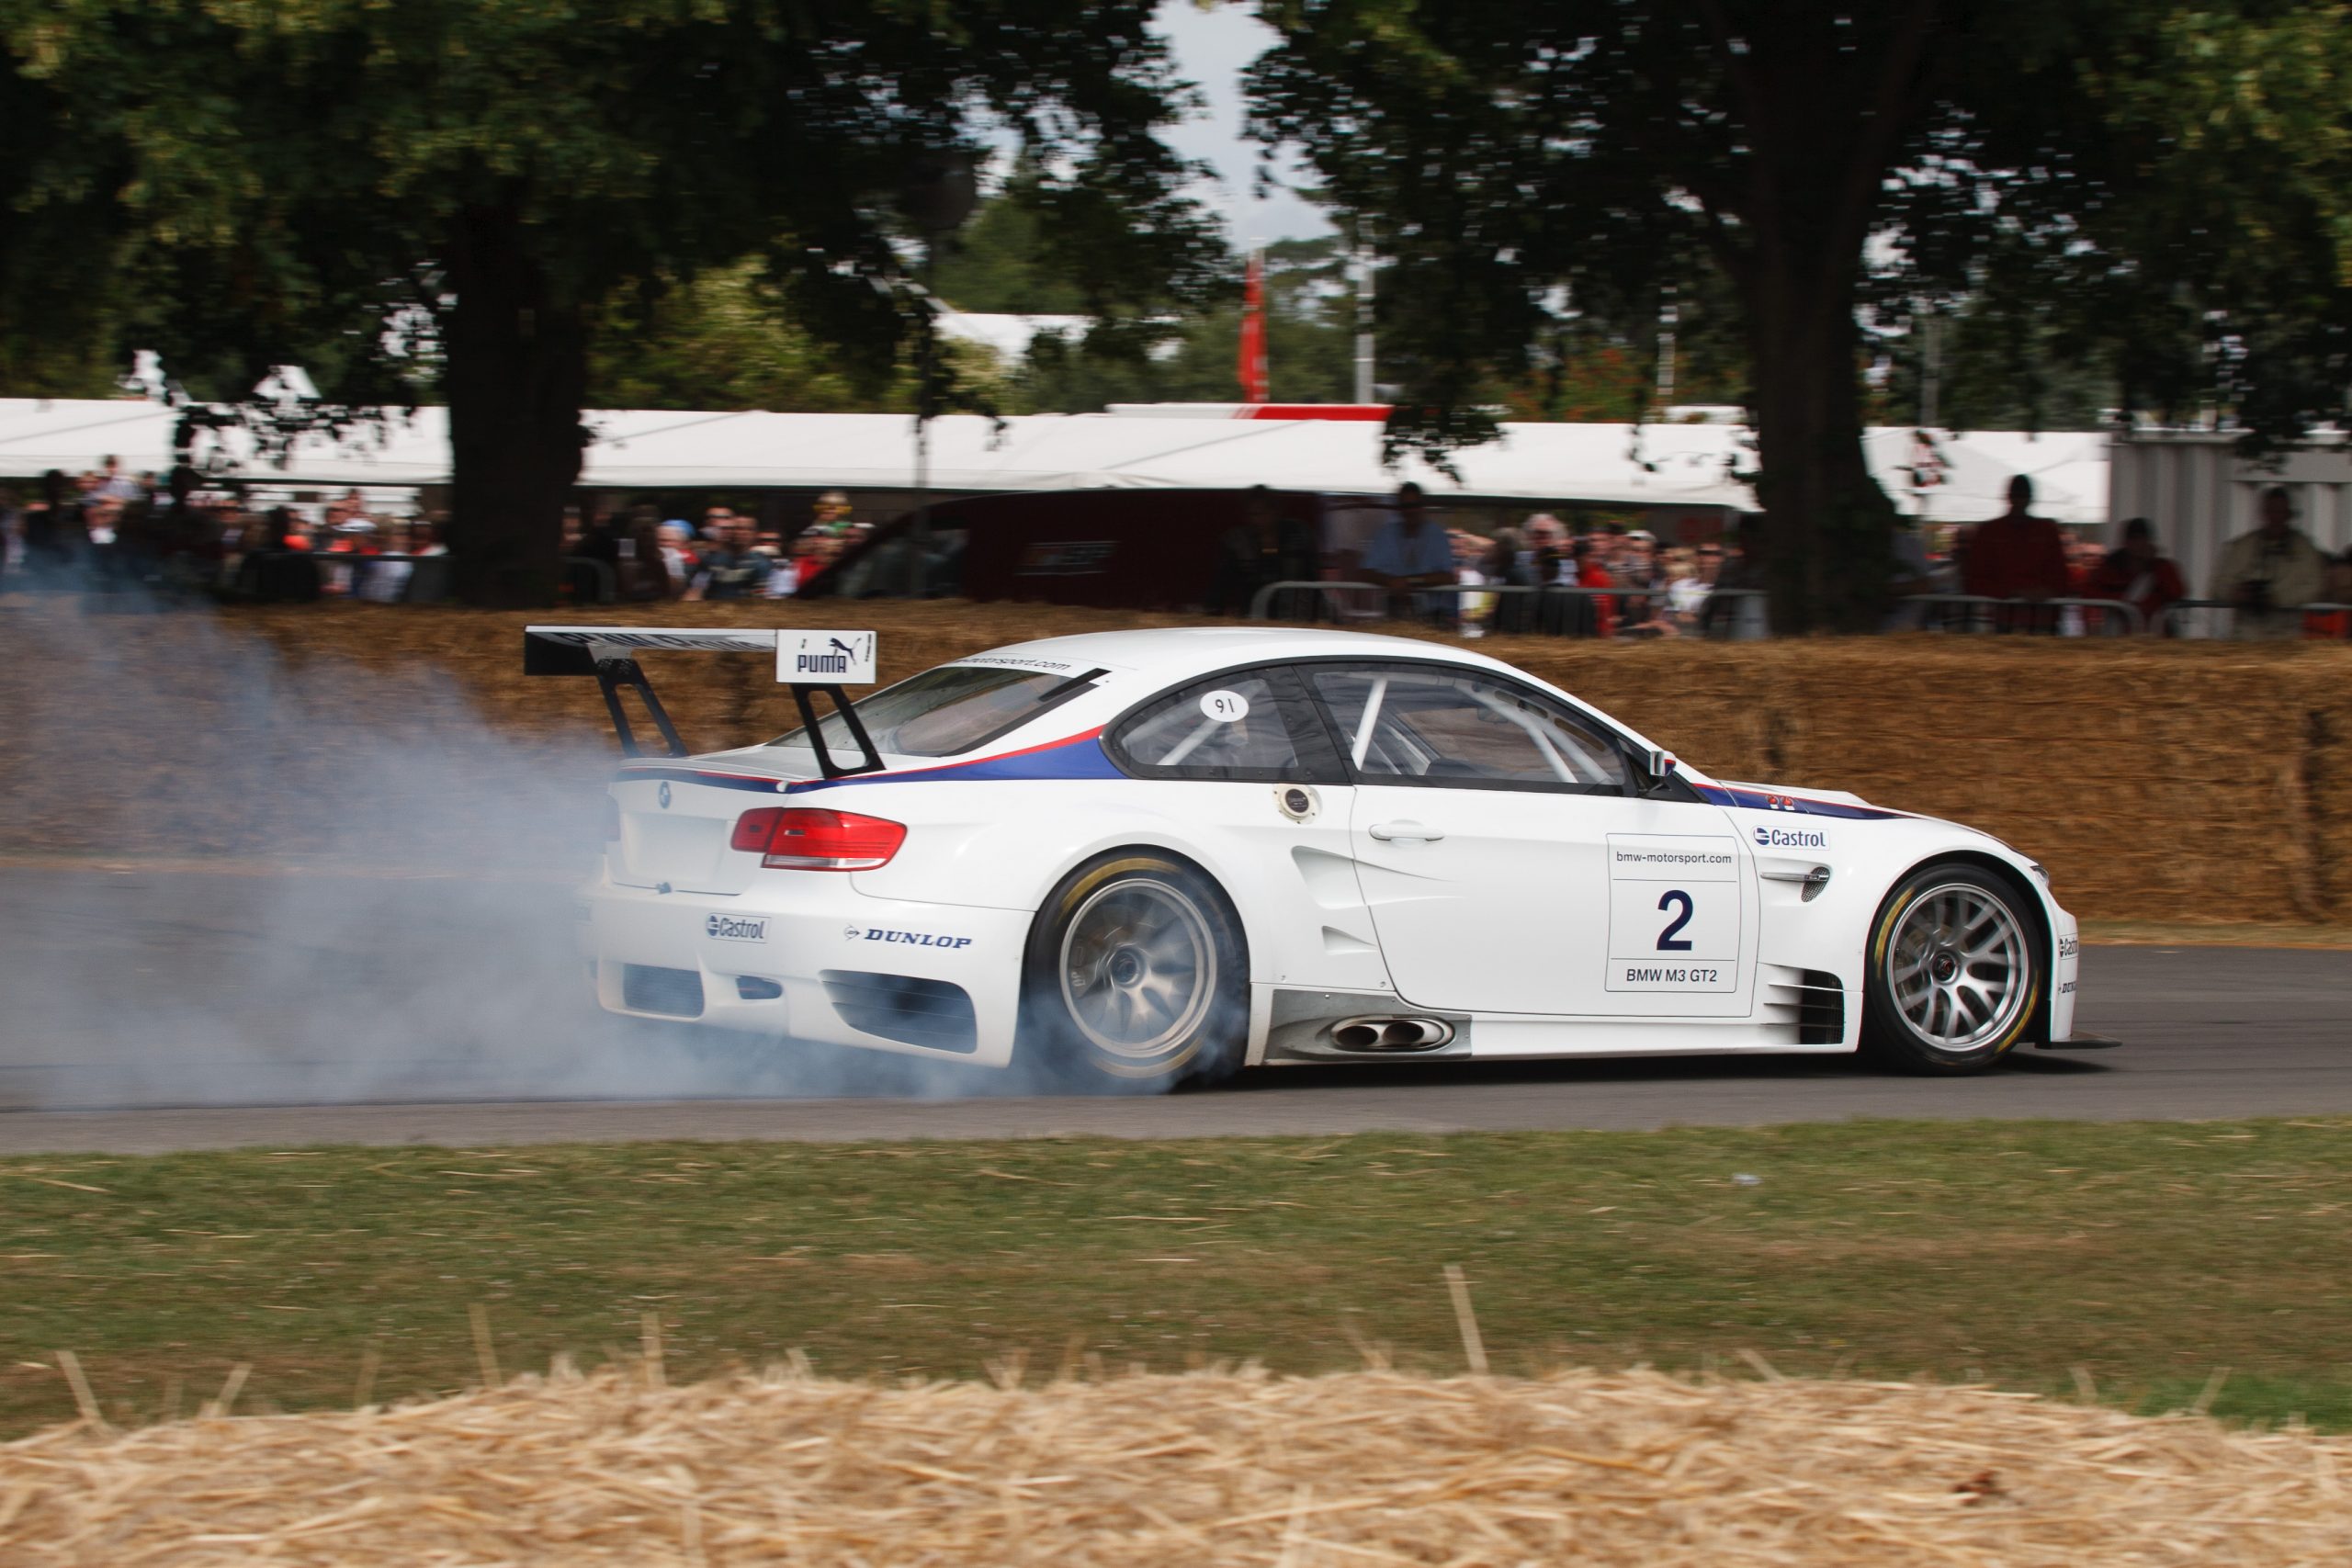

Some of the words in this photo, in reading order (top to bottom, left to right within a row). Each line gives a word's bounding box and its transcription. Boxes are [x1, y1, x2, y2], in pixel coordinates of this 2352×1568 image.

[797, 654, 846, 673] PUMA
[1771, 829, 1826, 847] Castrol
[1616, 851, 1732, 864] bmw-motorsport.com
[719, 917, 765, 940] Castrol
[1656, 889, 1693, 951] 2
[864, 929, 973, 949] DUNLOP
[1626, 968, 1662, 982] BMW
[1665, 969, 1686, 982] M3
[1690, 969, 1717, 982] GT2
